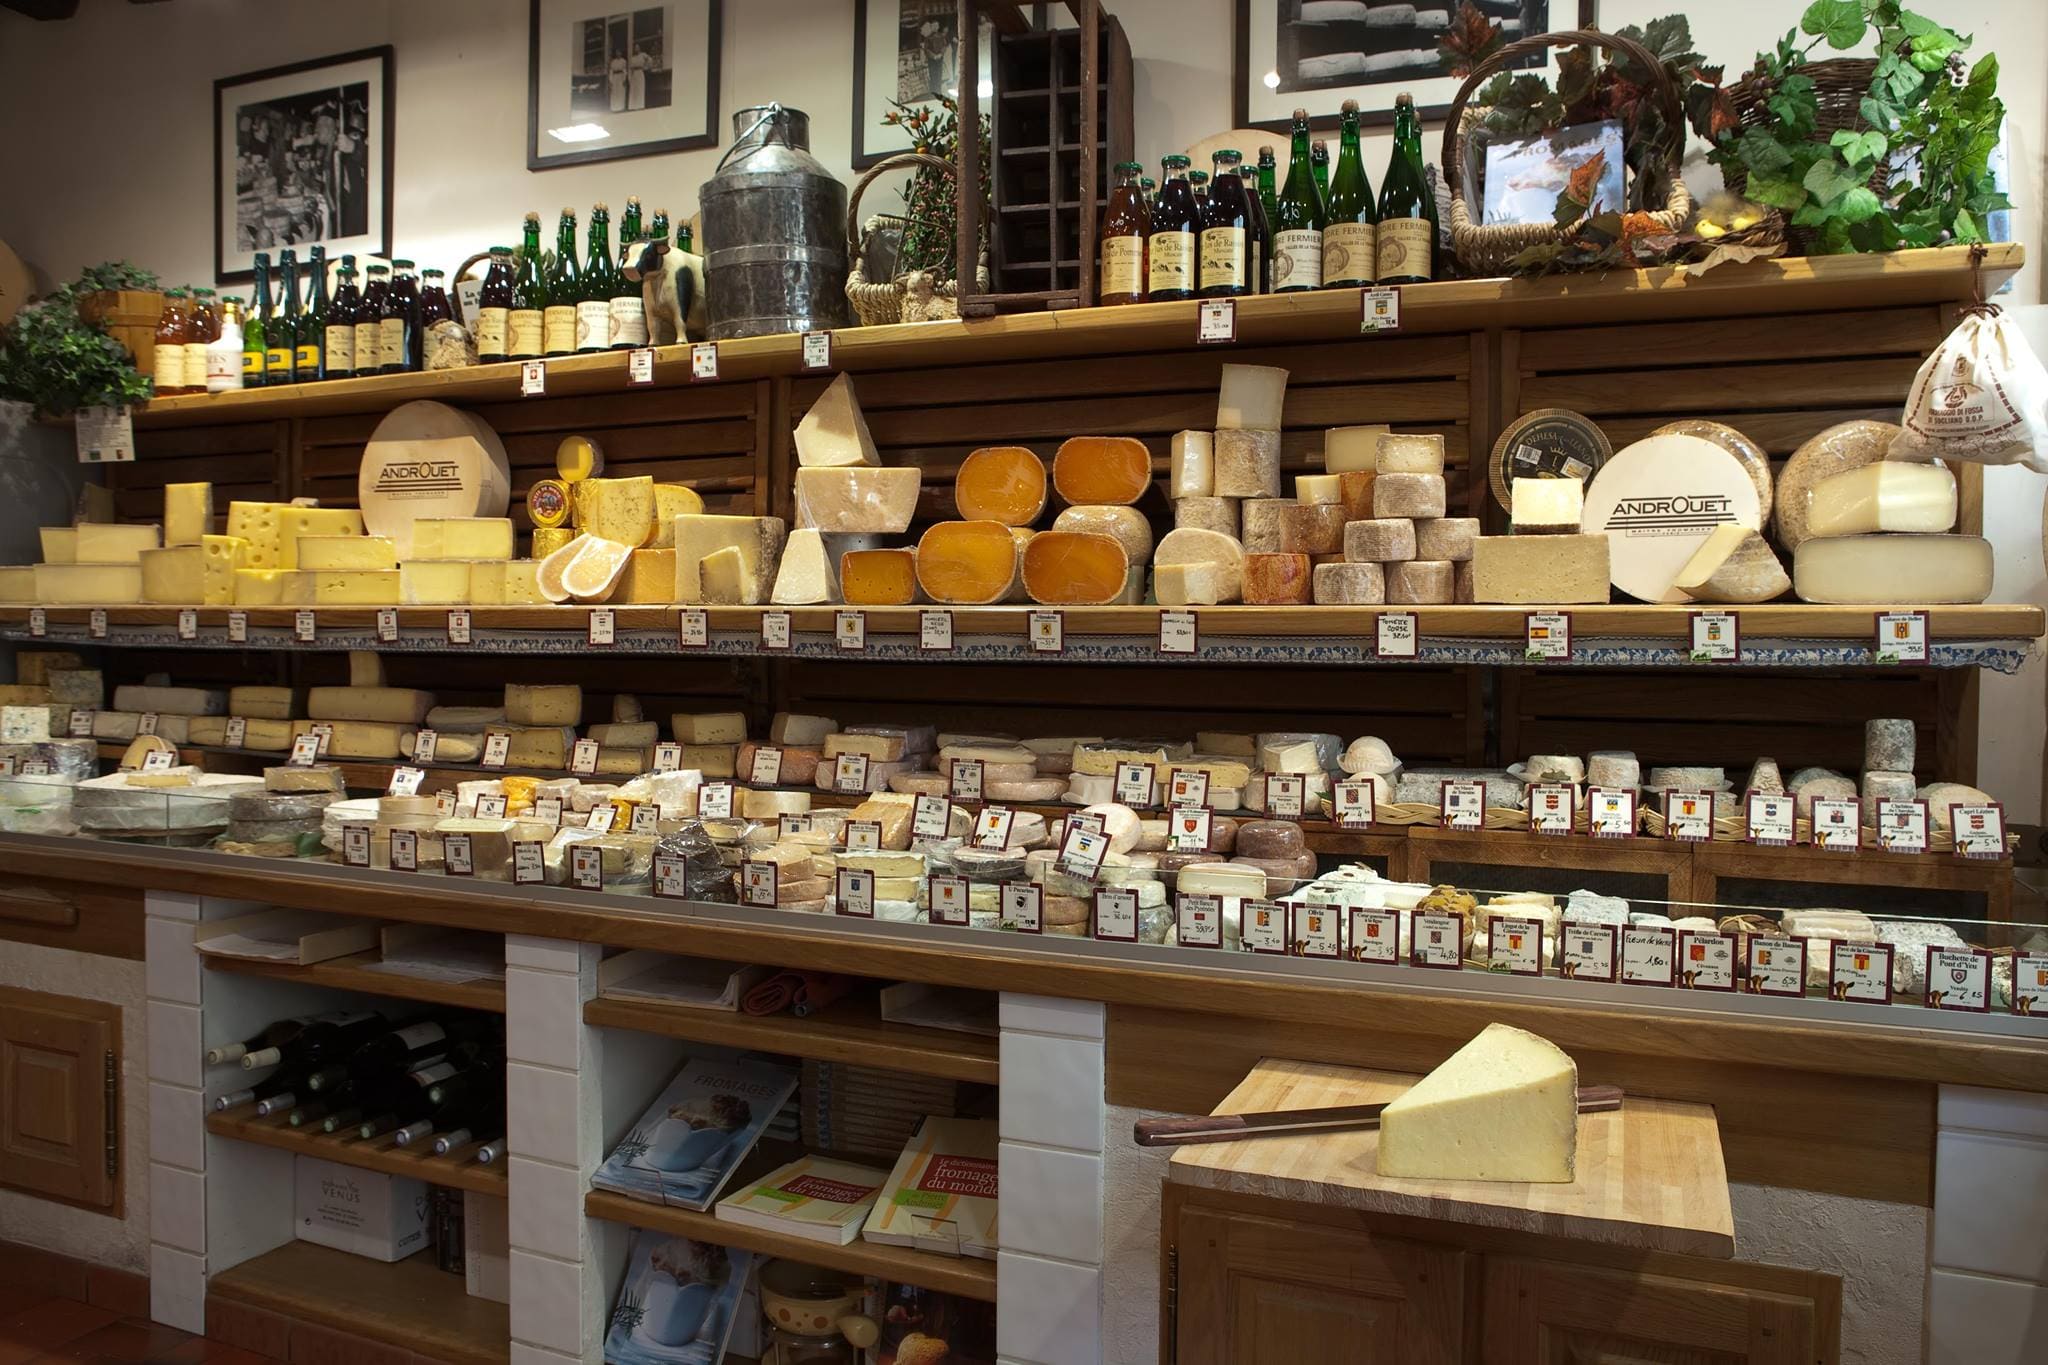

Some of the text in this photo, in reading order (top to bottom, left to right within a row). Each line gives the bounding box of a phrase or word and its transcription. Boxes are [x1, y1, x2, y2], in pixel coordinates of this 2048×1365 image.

[380, 462, 459, 479] ANDROUET
[1613, 496, 1732, 515] ANDROUET
[1694, 937, 1724, 945] Pélardon
[1939, 953, 1968, 962] Buchette
[1940, 960, 1958, 968] Pont
[694, 1074, 779, 1098] FROMAGES
[934, 1164, 999, 1185] fromage
[322, 1186, 360, 1203] VENUS
[800, 1182, 864, 1197] fromages
[926, 1177, 999, 1195] du monde
[808, 1190, 855, 1203] monde
